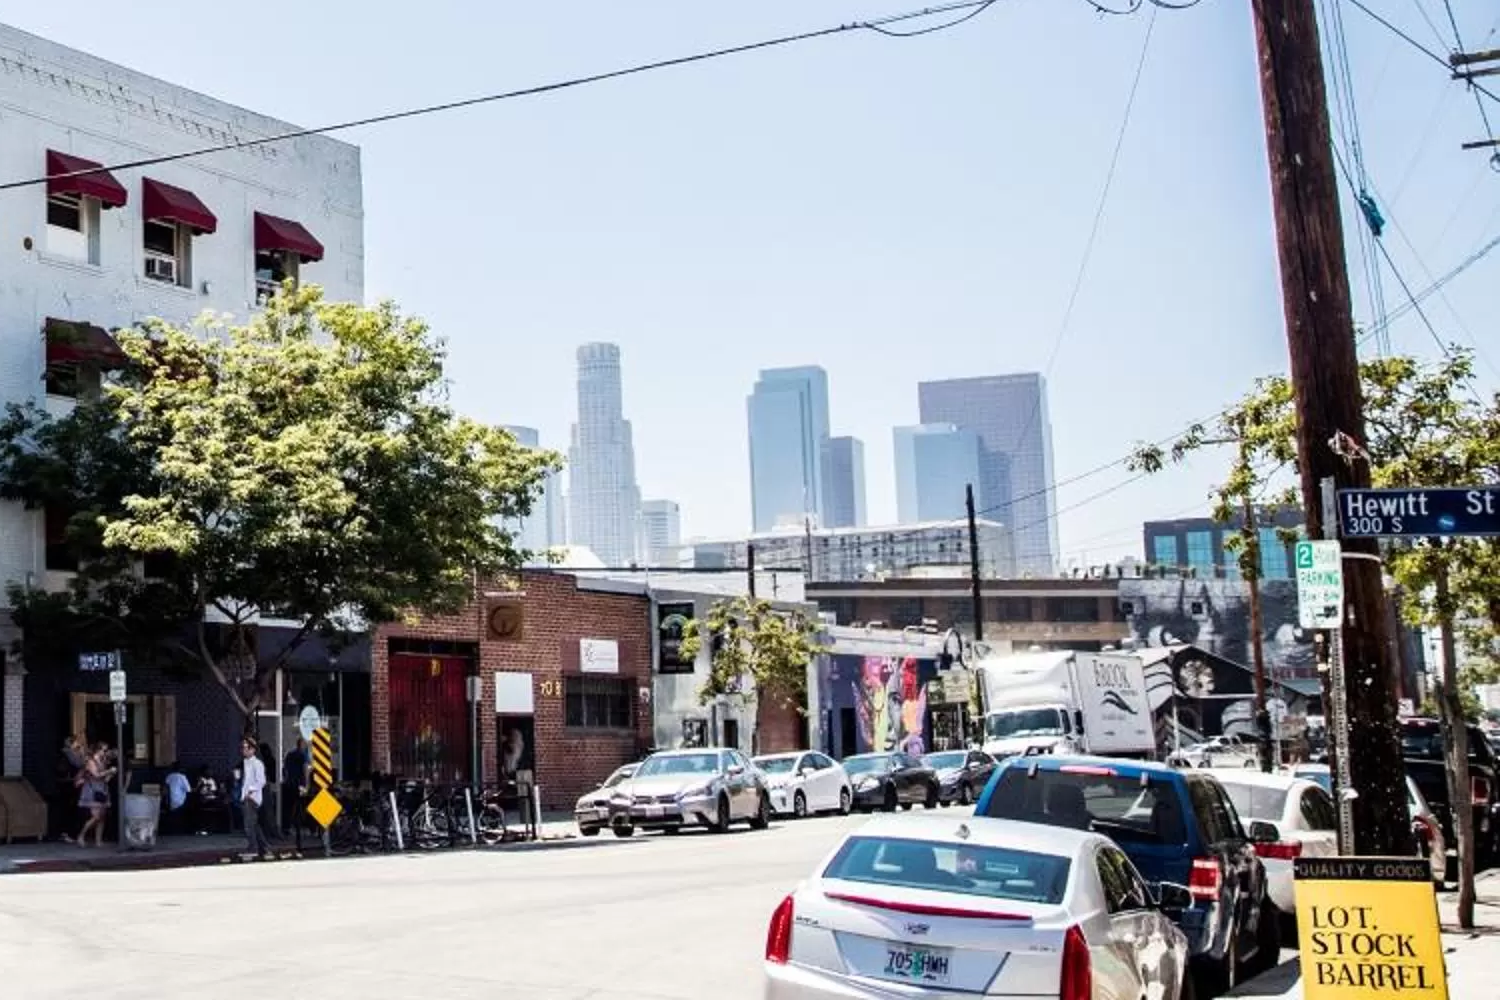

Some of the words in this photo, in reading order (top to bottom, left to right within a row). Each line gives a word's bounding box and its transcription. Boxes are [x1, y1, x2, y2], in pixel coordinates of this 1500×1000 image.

[1347, 492, 1429, 517] Hewitt
[1466, 490, 1495, 515] St
[1349, 517, 1383, 533] 300
[1392, 517, 1403, 533] S
[1299, 545, 1310, 565] 2
[1299, 862, 1367, 877] QUALITY
[1373, 863, 1425, 878] GOODS
[1311, 931, 1416, 958] STOCK
[887, 950, 913, 970] 705
[1316, 961, 1435, 991] BARREL
